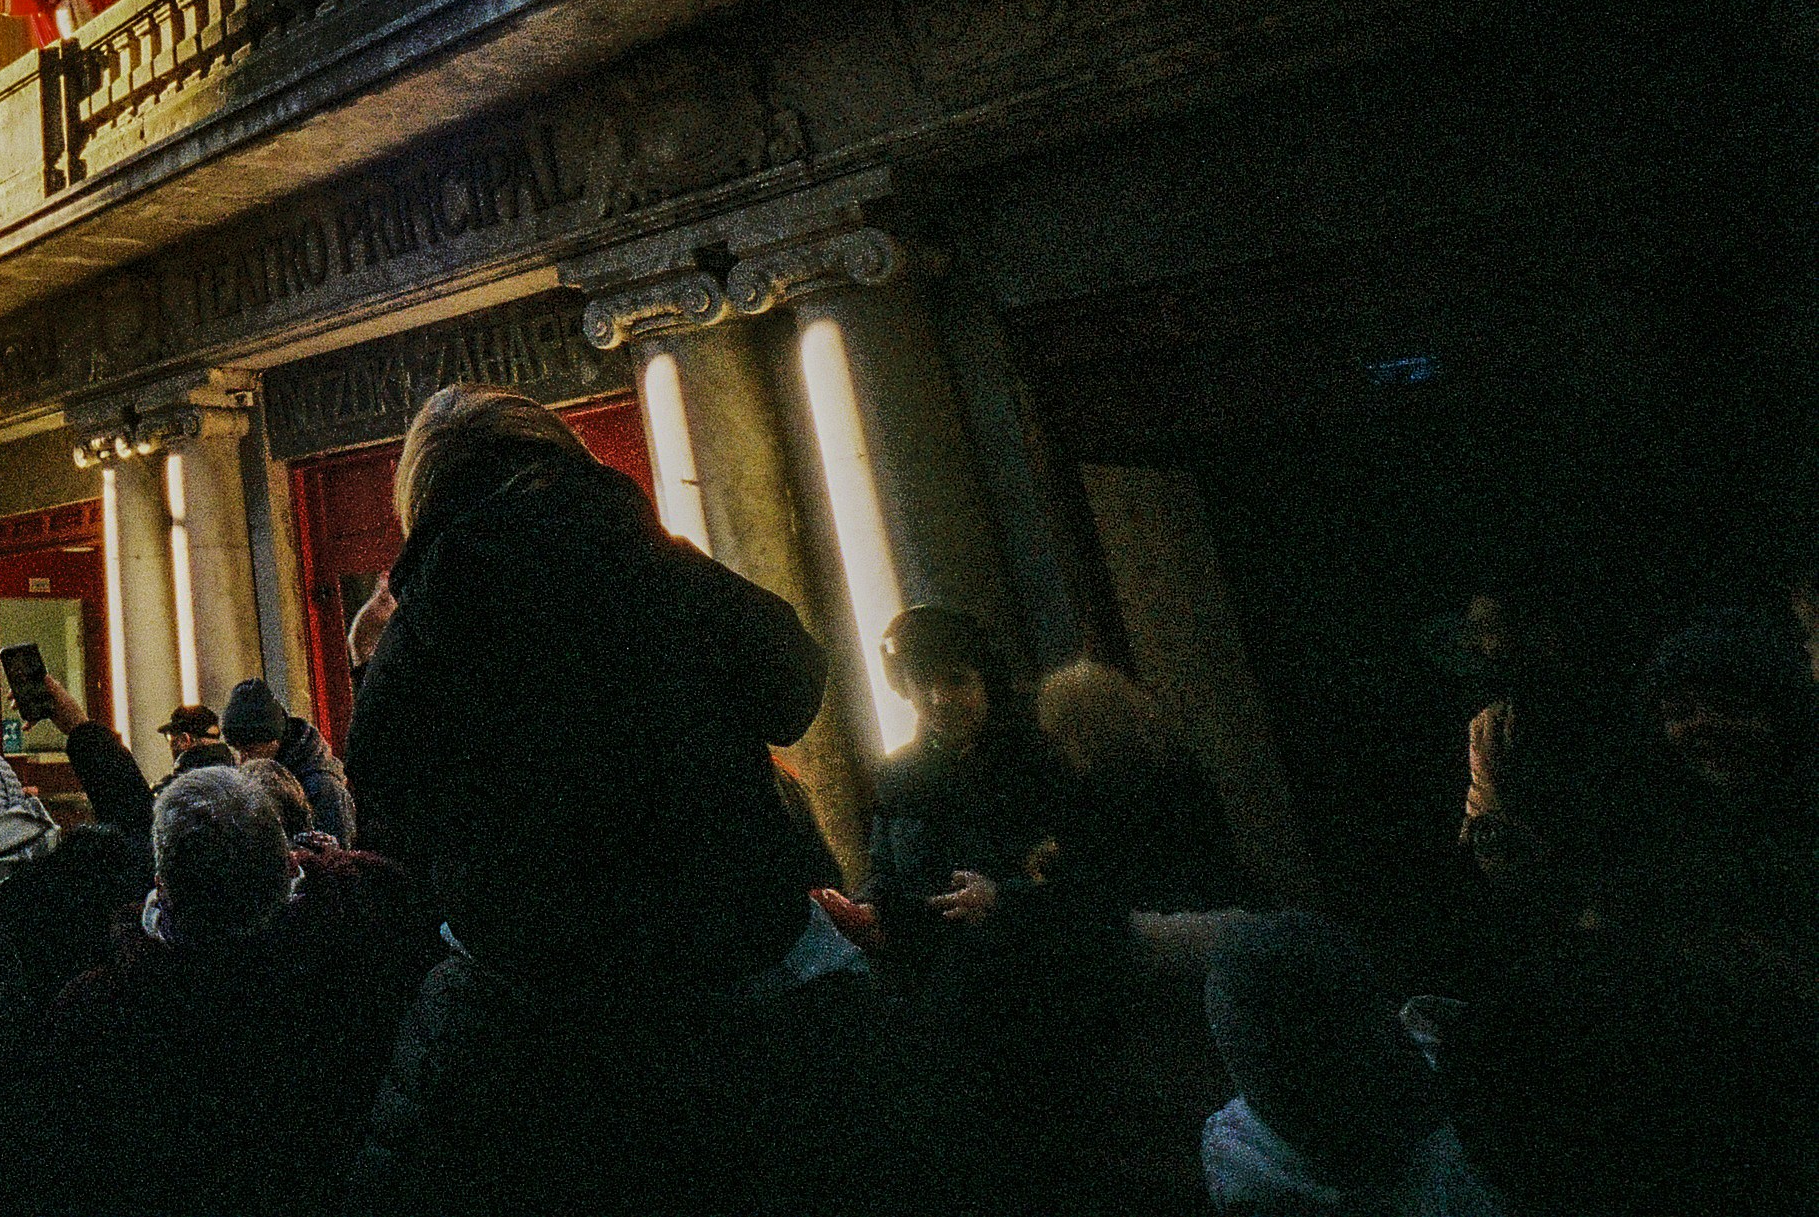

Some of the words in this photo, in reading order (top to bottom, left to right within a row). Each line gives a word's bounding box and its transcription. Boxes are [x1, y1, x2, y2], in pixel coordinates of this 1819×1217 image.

[186, 218, 329, 325] TEATRO
[338, 125, 583, 274] PRINCIPAL
[418, 310, 592, 391] ZAHARR
